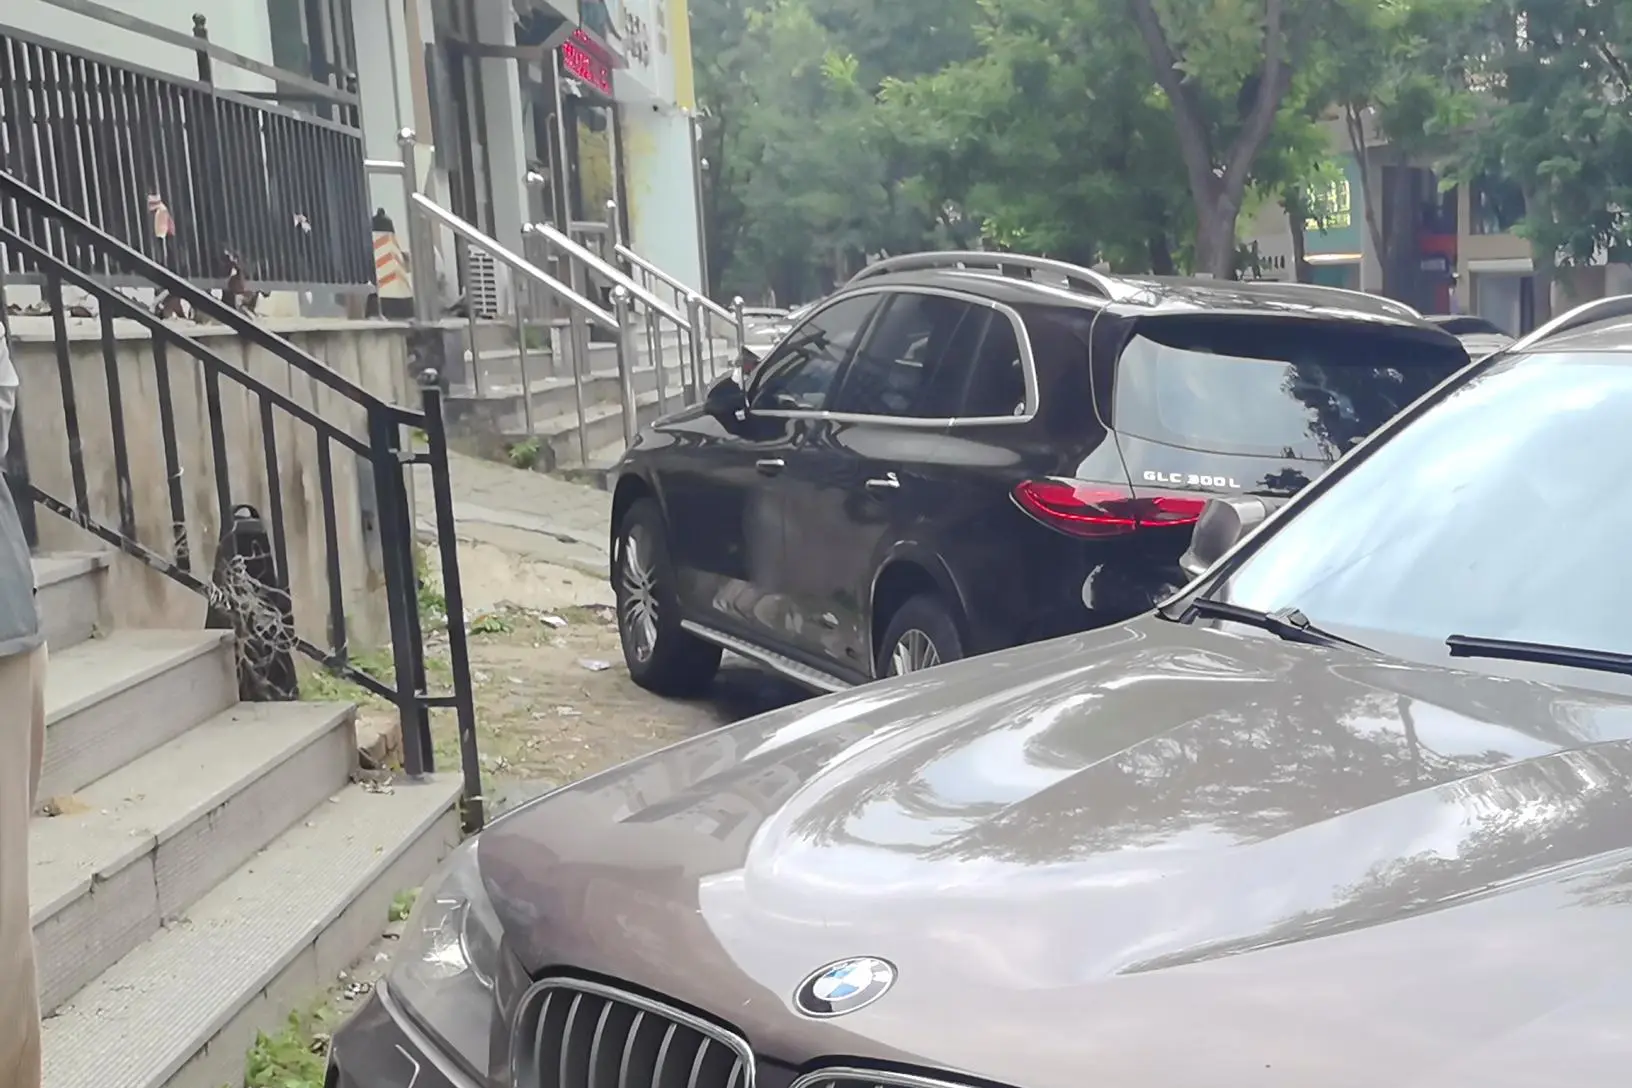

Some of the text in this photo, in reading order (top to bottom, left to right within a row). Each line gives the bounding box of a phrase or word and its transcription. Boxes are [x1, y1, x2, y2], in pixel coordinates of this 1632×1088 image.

[1143, 470, 1241, 488] GLC 300 L
